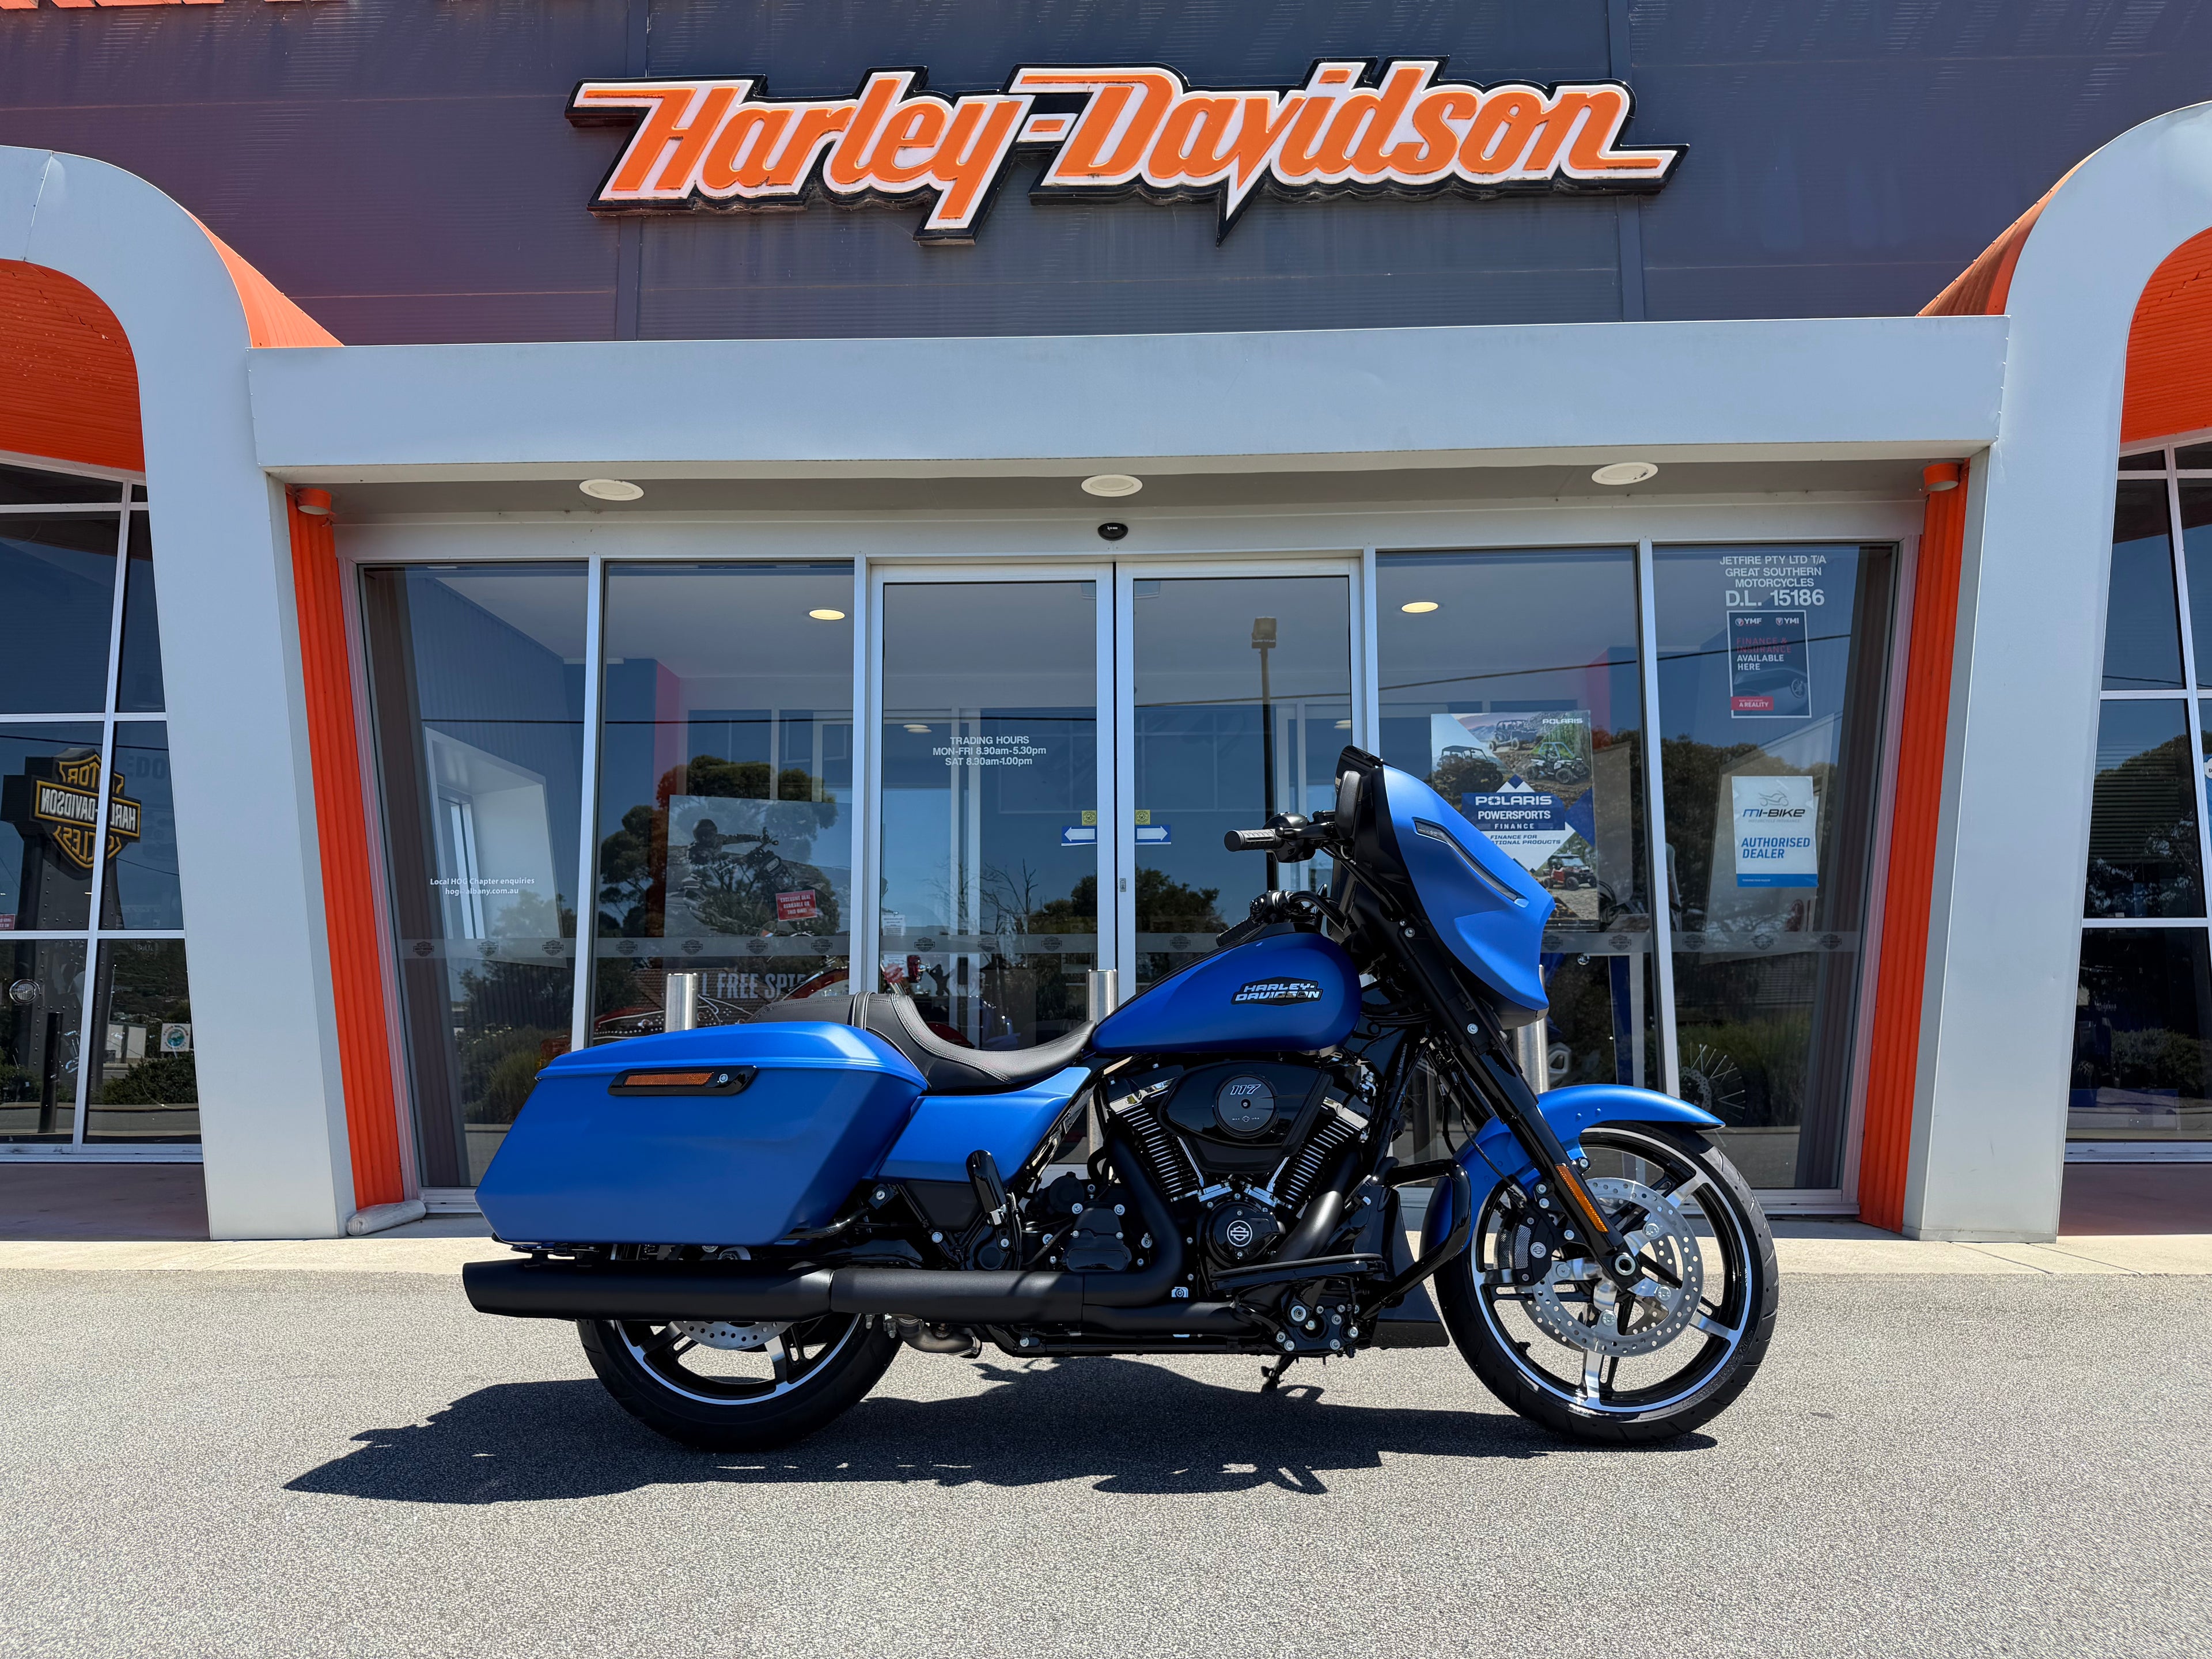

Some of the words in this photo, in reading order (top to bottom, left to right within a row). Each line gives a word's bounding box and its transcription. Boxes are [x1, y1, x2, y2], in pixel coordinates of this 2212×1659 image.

[573, 61, 1676, 230] Harley-Davidson
[1719, 556, 1762, 565] JETFIRE
[1764, 555, 1786, 565] PTY
[1789, 555, 1808, 564] LTD
[1810, 555, 1827, 565] T/A
[1725, 567, 1760, 577] GREAT
[1763, 567, 1822, 576] SOUTHERN
[1735, 578, 1815, 588] MOTORCYCLES
[1725, 590, 1762, 607] D.L.
[1770, 589, 1825, 606] 15186
[950, 736, 993, 744] TRADING
[996, 736, 1029, 744] HOURS
[933, 747, 973, 755] MON-FRI
[945, 757, 964, 766] SAT
[1475, 796, 1552, 805] POLARIS
[1478, 810, 1551, 820] POWERSPORTS
[1741, 838, 1810, 847] AUTHORISED
[1743, 849, 1785, 858] DEALER
[469, 878, 499, 886] Chapter
[500, 877, 535, 886] enquiries
[717, 973, 759, 999] FREE
[1243, 983, 1315, 993] HARLEY-
[1235, 991, 1320, 1001] DAVIDSON
[1230, 1084, 1262, 1095] 117
